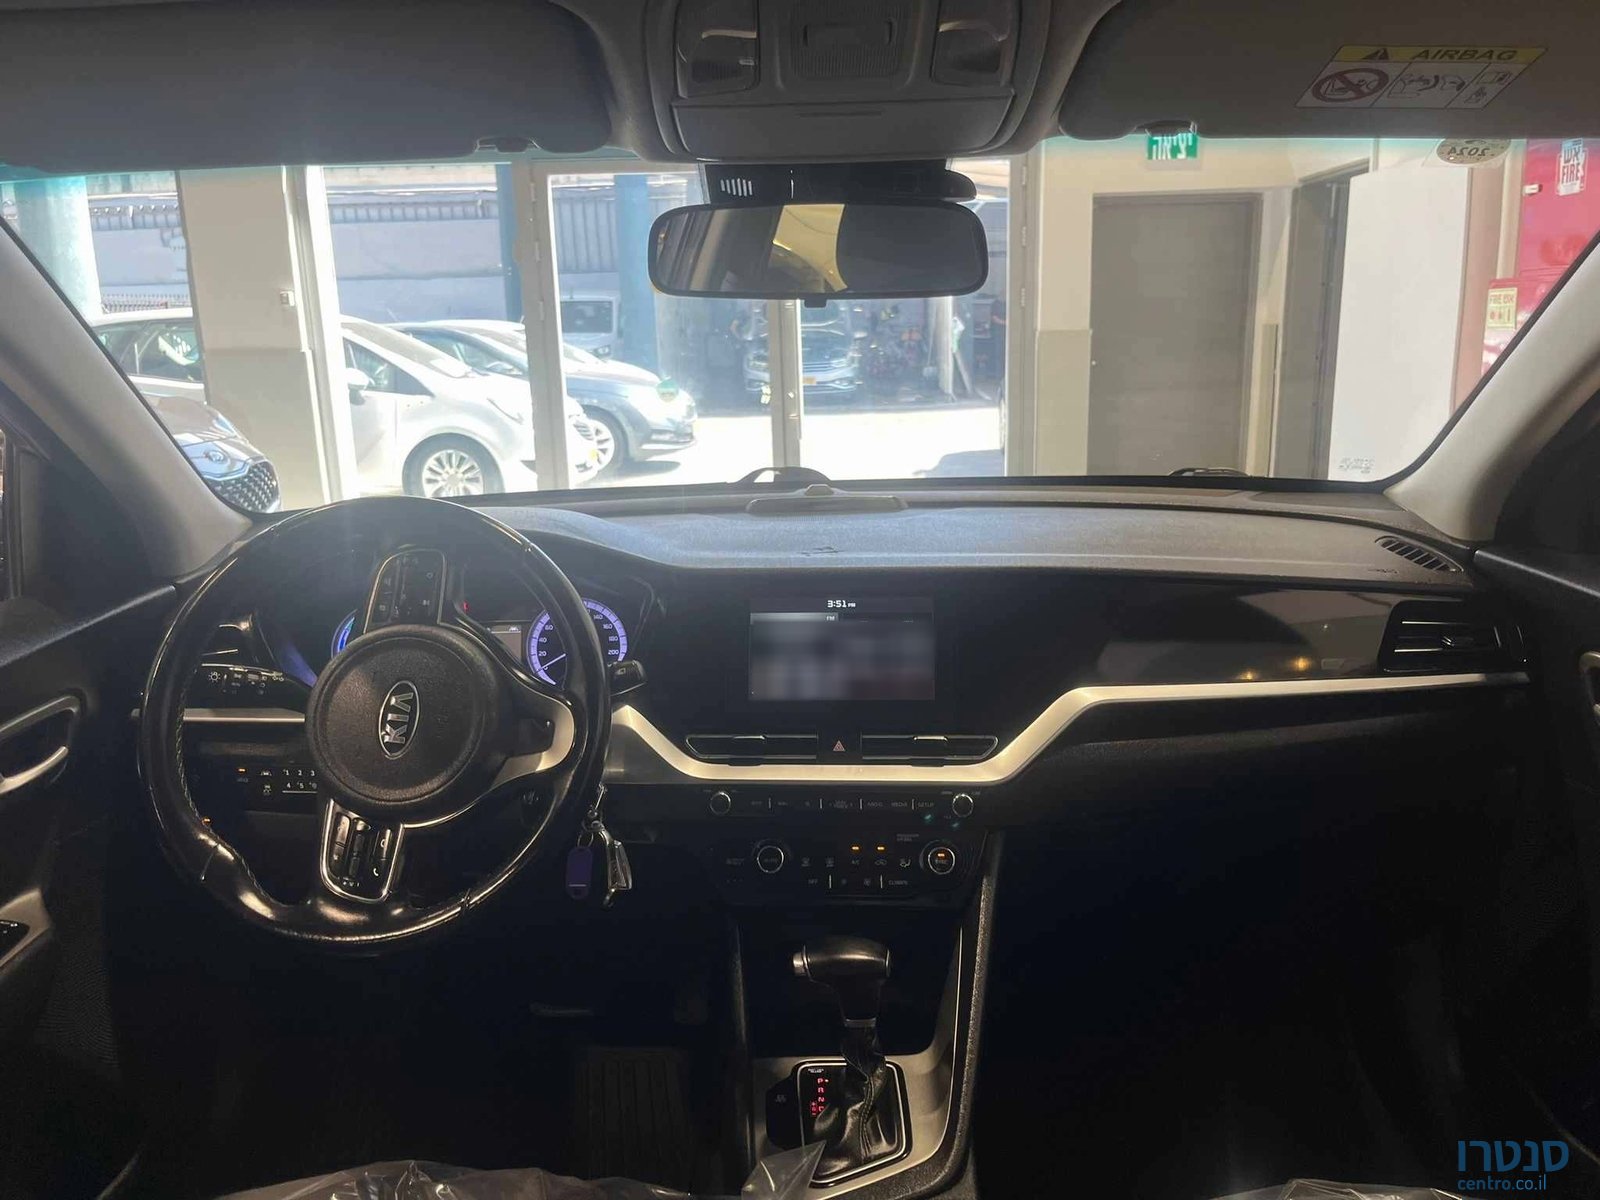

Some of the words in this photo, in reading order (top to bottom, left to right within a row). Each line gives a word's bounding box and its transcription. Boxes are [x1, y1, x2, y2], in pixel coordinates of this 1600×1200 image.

[1410, 49, 1518, 60] AIRBAG
[1561, 164, 1579, 184] FIRE
[826, 600, 846, 608] 3:51
[384, 692, 414, 744] KIA
